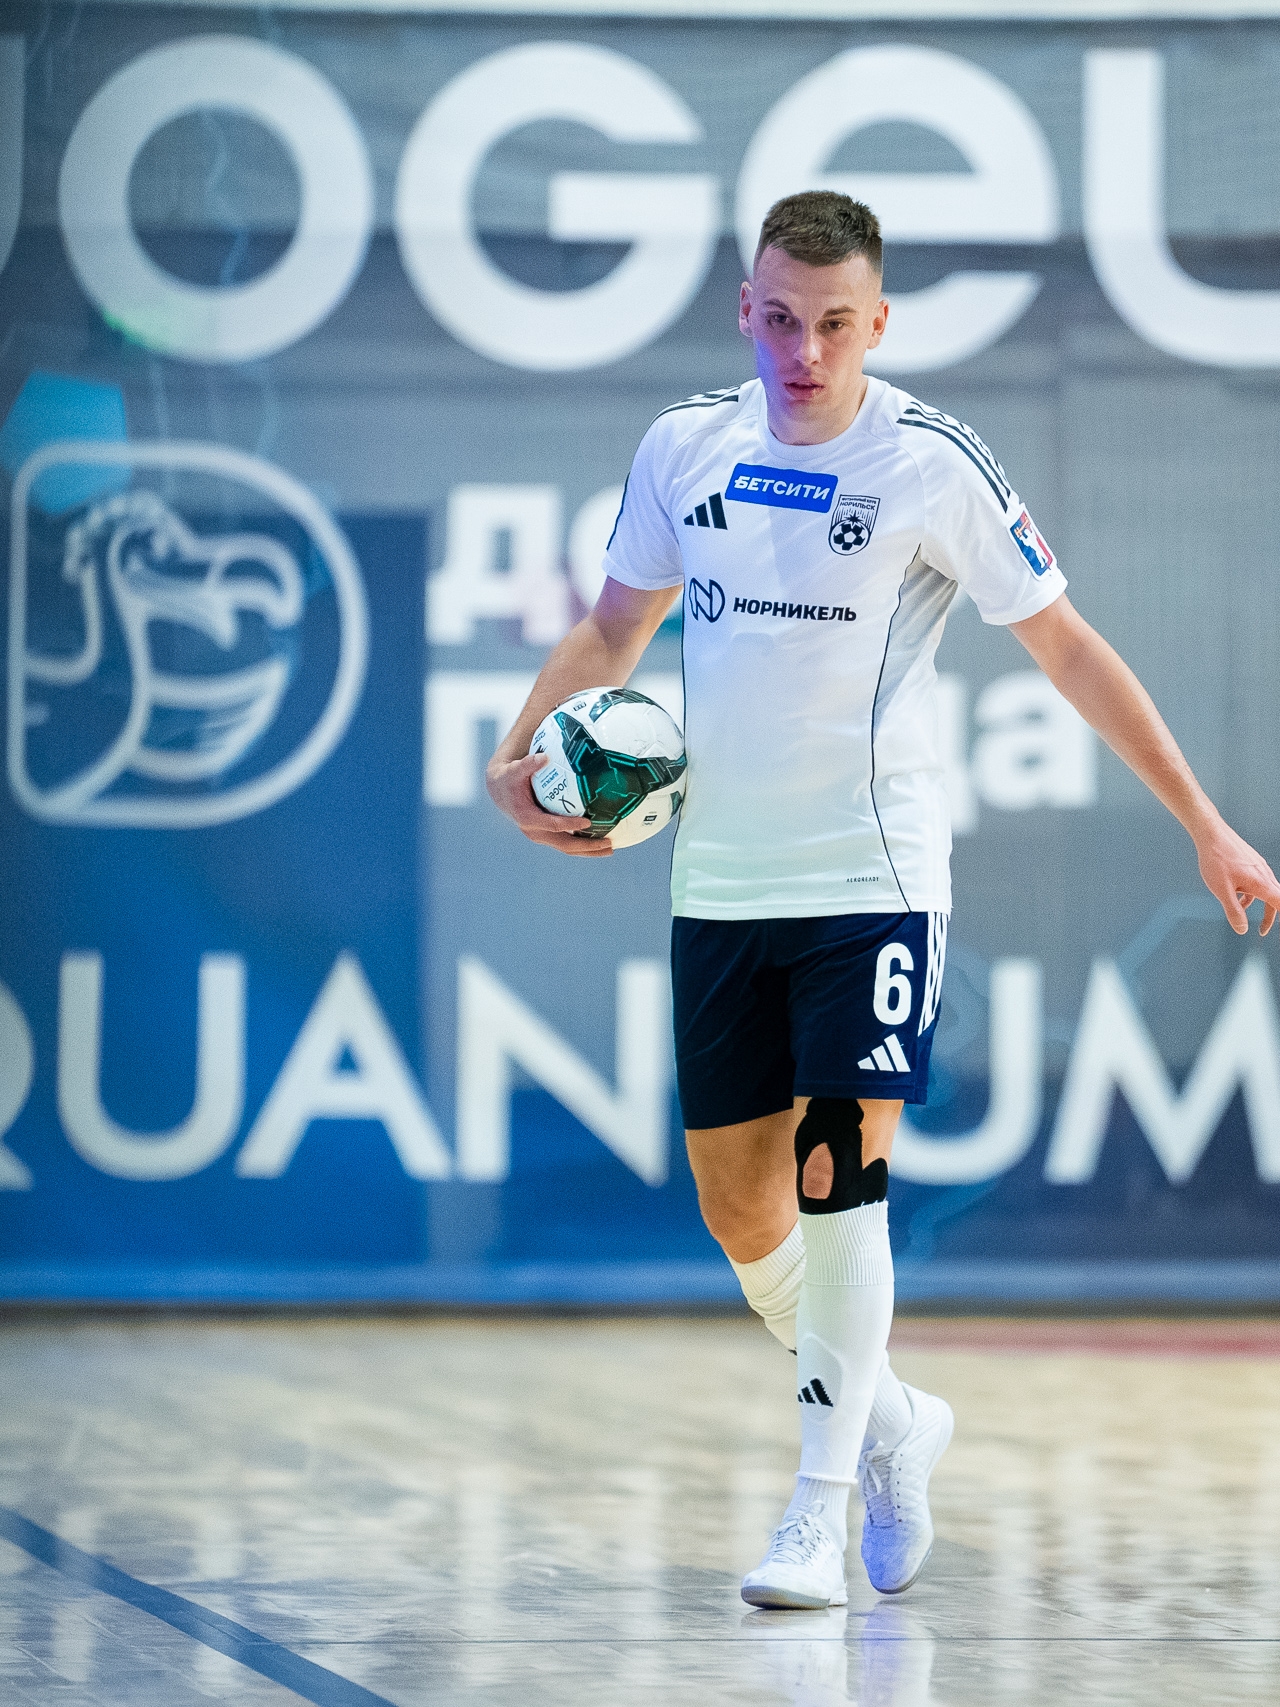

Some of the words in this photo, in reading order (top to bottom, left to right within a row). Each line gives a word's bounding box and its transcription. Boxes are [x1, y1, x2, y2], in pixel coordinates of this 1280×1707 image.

[734, 475, 830, 501] БЕТСИТИ
[839, 501, 876, 511] НОРИЛЬСК
[733, 598, 857, 621] НОРНИКЕЛЬ
[873, 942, 915, 1026] 6
